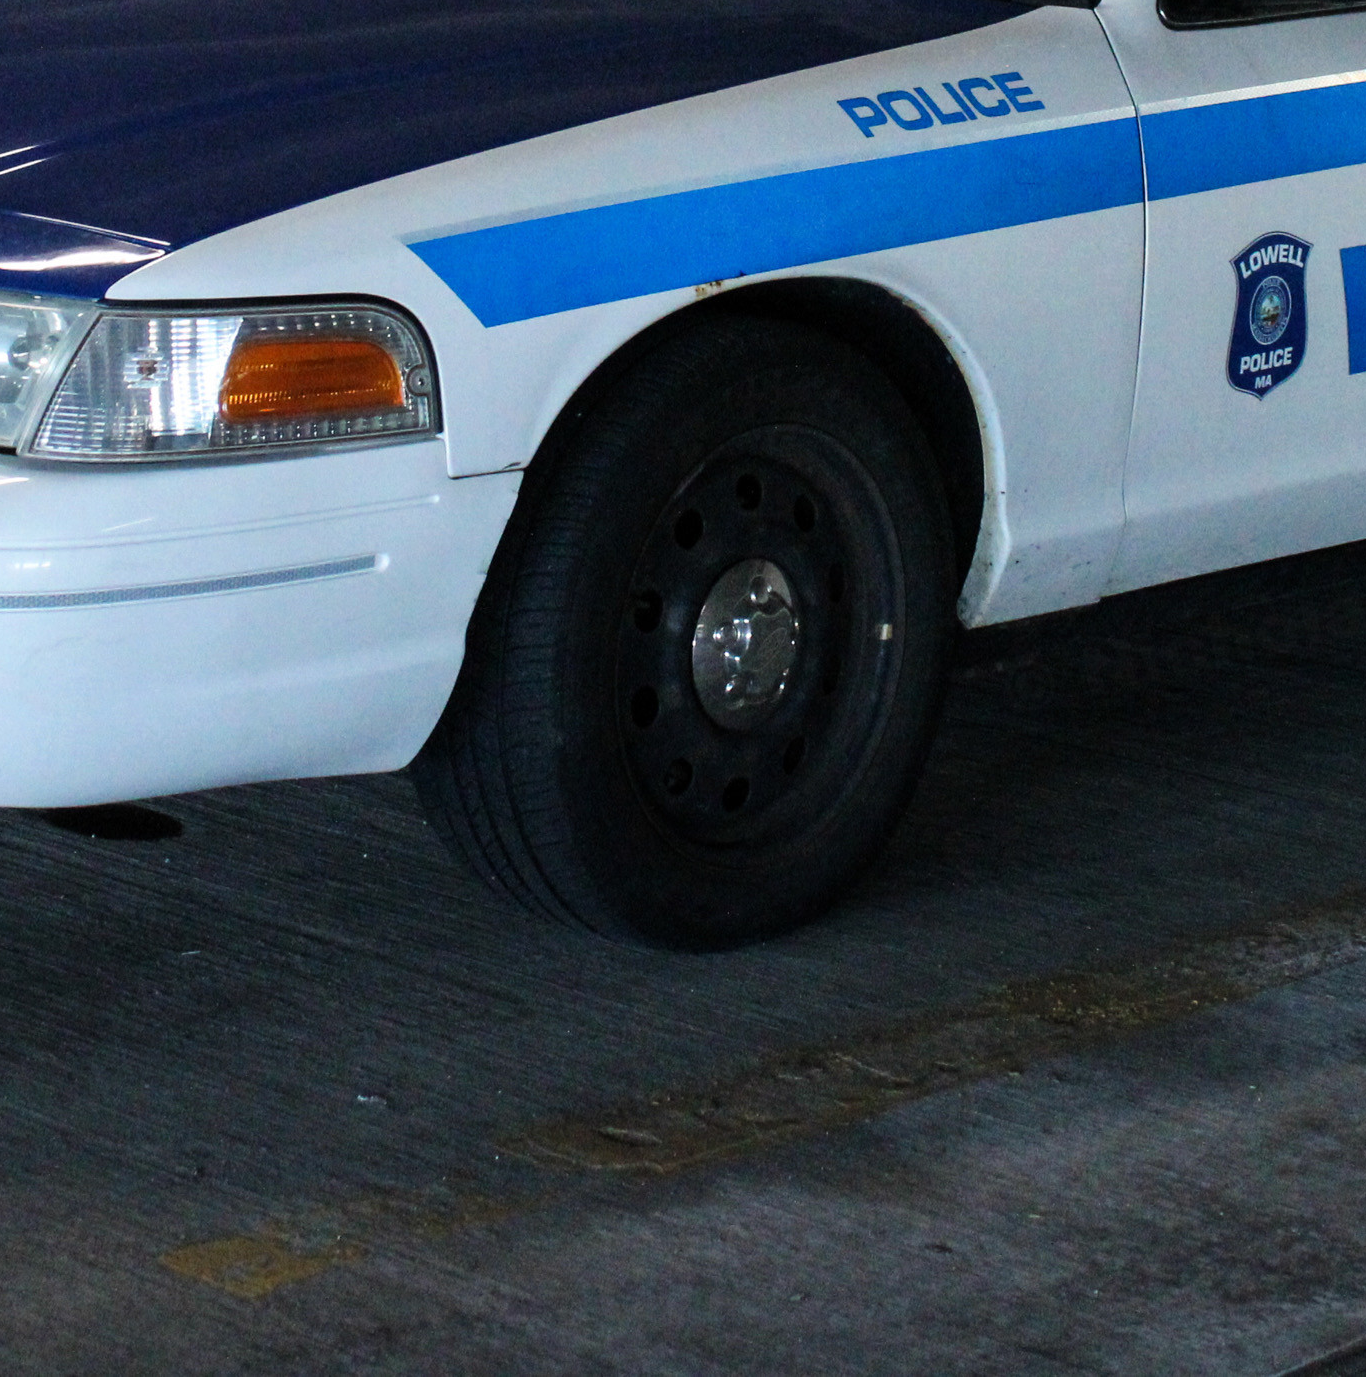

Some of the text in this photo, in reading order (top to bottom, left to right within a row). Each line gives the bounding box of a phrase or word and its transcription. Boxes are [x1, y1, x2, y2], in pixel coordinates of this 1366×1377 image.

[836, 71, 1046, 138] POLICE
[1239, 243, 1305, 279] LOWELL
[1239, 346, 1294, 375] POLICE
[1254, 374, 1273, 389] MA
